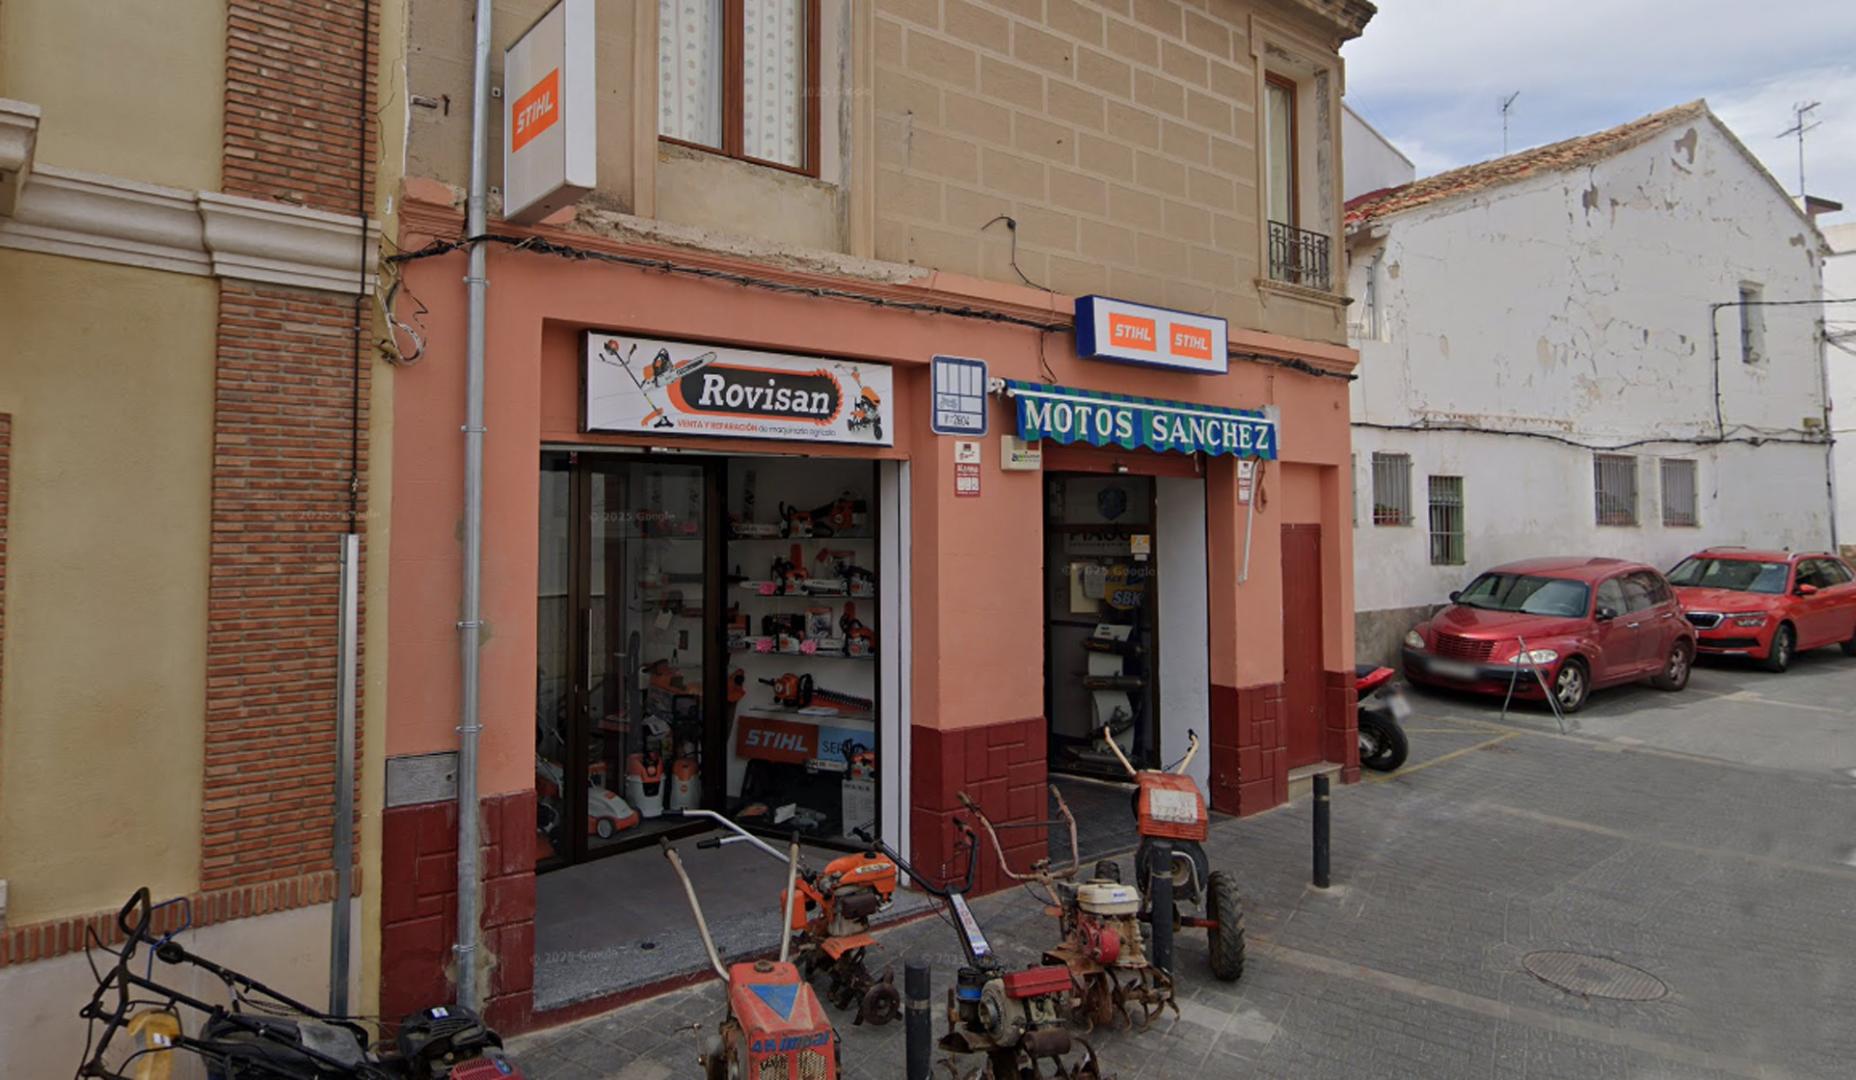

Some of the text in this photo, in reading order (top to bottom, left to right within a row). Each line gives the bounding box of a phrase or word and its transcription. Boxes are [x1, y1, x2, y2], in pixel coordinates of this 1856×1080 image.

[517, 91, 553, 134] STIHL
[1114, 323, 1151, 341] STIHL
[1175, 333, 1208, 350] STIHL
[699, 374, 830, 414] Rovisan
[677, 418, 703, 428] VENTA
[759, 424, 768, 432] de
[1025, 399, 1133, 438] MOTOS
[1152, 415, 1269, 449] SANCHEZ
[1112, 591, 1142, 607] SBK
[745, 729, 808, 752] STIHL
